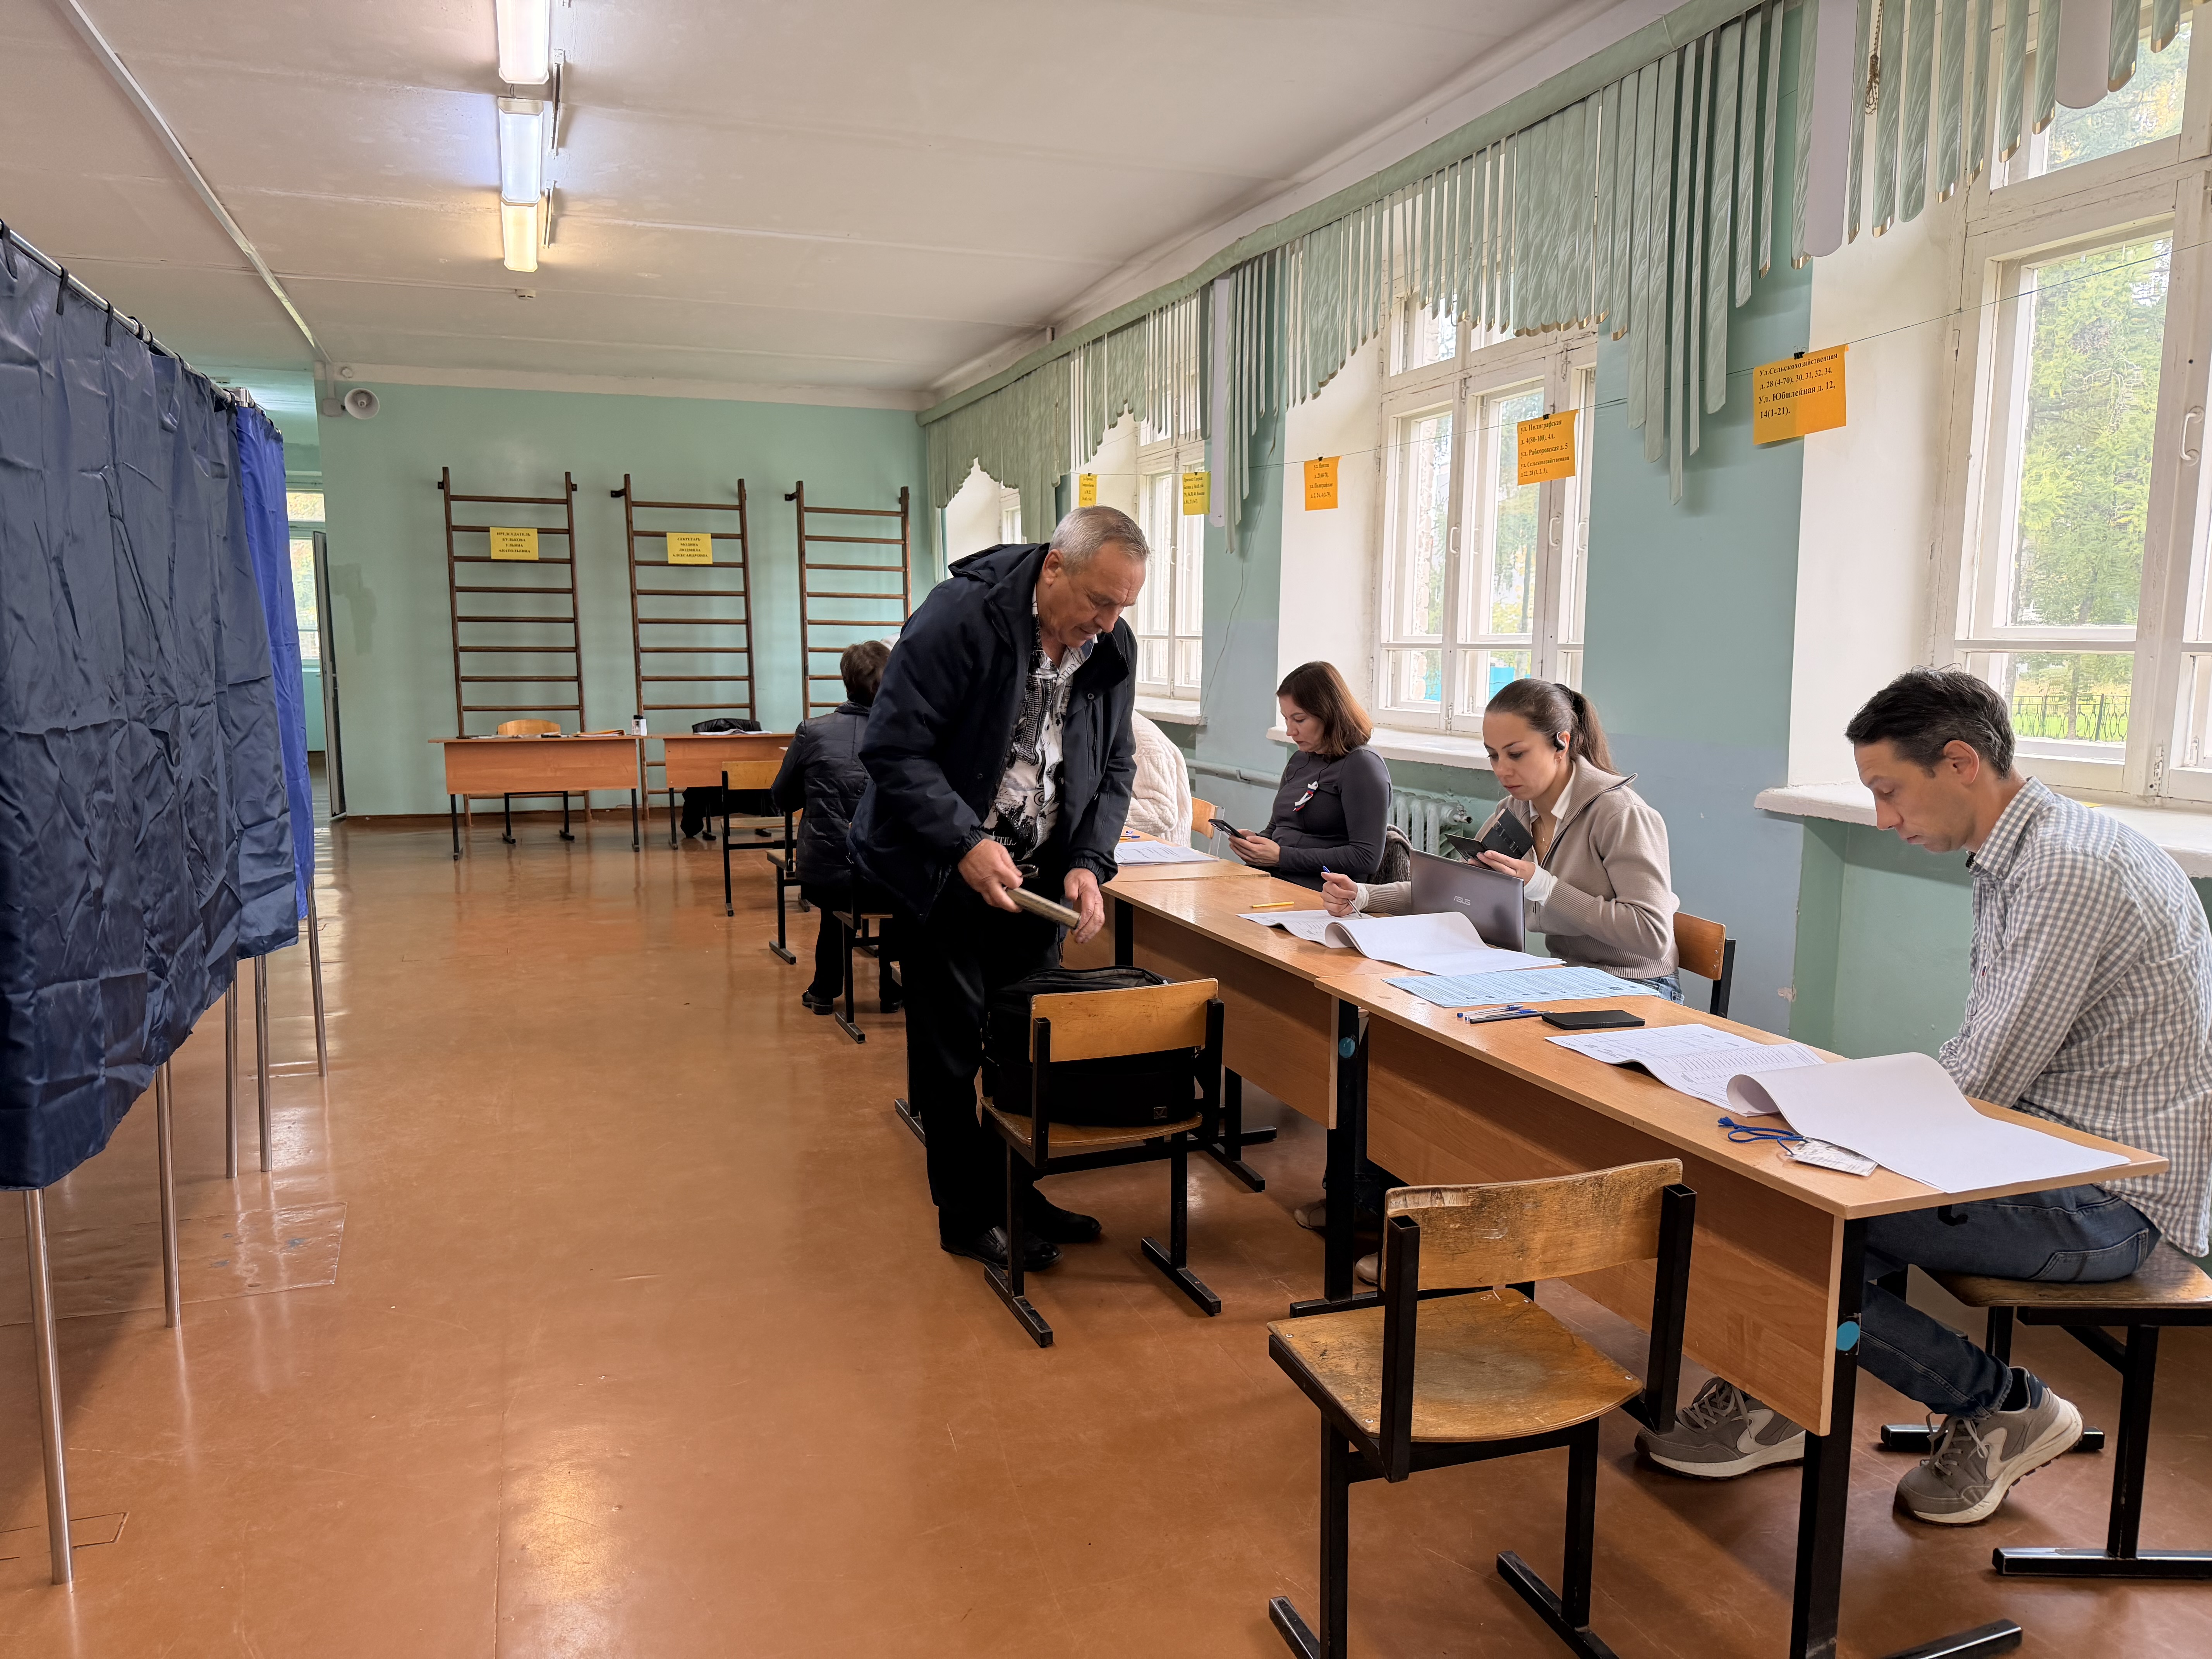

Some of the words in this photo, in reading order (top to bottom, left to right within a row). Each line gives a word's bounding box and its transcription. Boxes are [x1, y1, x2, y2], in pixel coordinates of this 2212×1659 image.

[1759, 353, 1838, 377] Ул.Сельскохозяйственная
[1775, 377, 1794, 387] (4-70),
[1795, 374, 1804, 382] 30,
[1759, 396, 1770, 404] Ул.
[1773, 387, 1815, 401] Юбилейная
[1826, 381, 1835, 390] 12,
[1760, 407, 1790, 419] 14(1-21).
[1528, 420, 1562, 431] Полиграфская
[1453, 895, 1471, 906] ASUS
